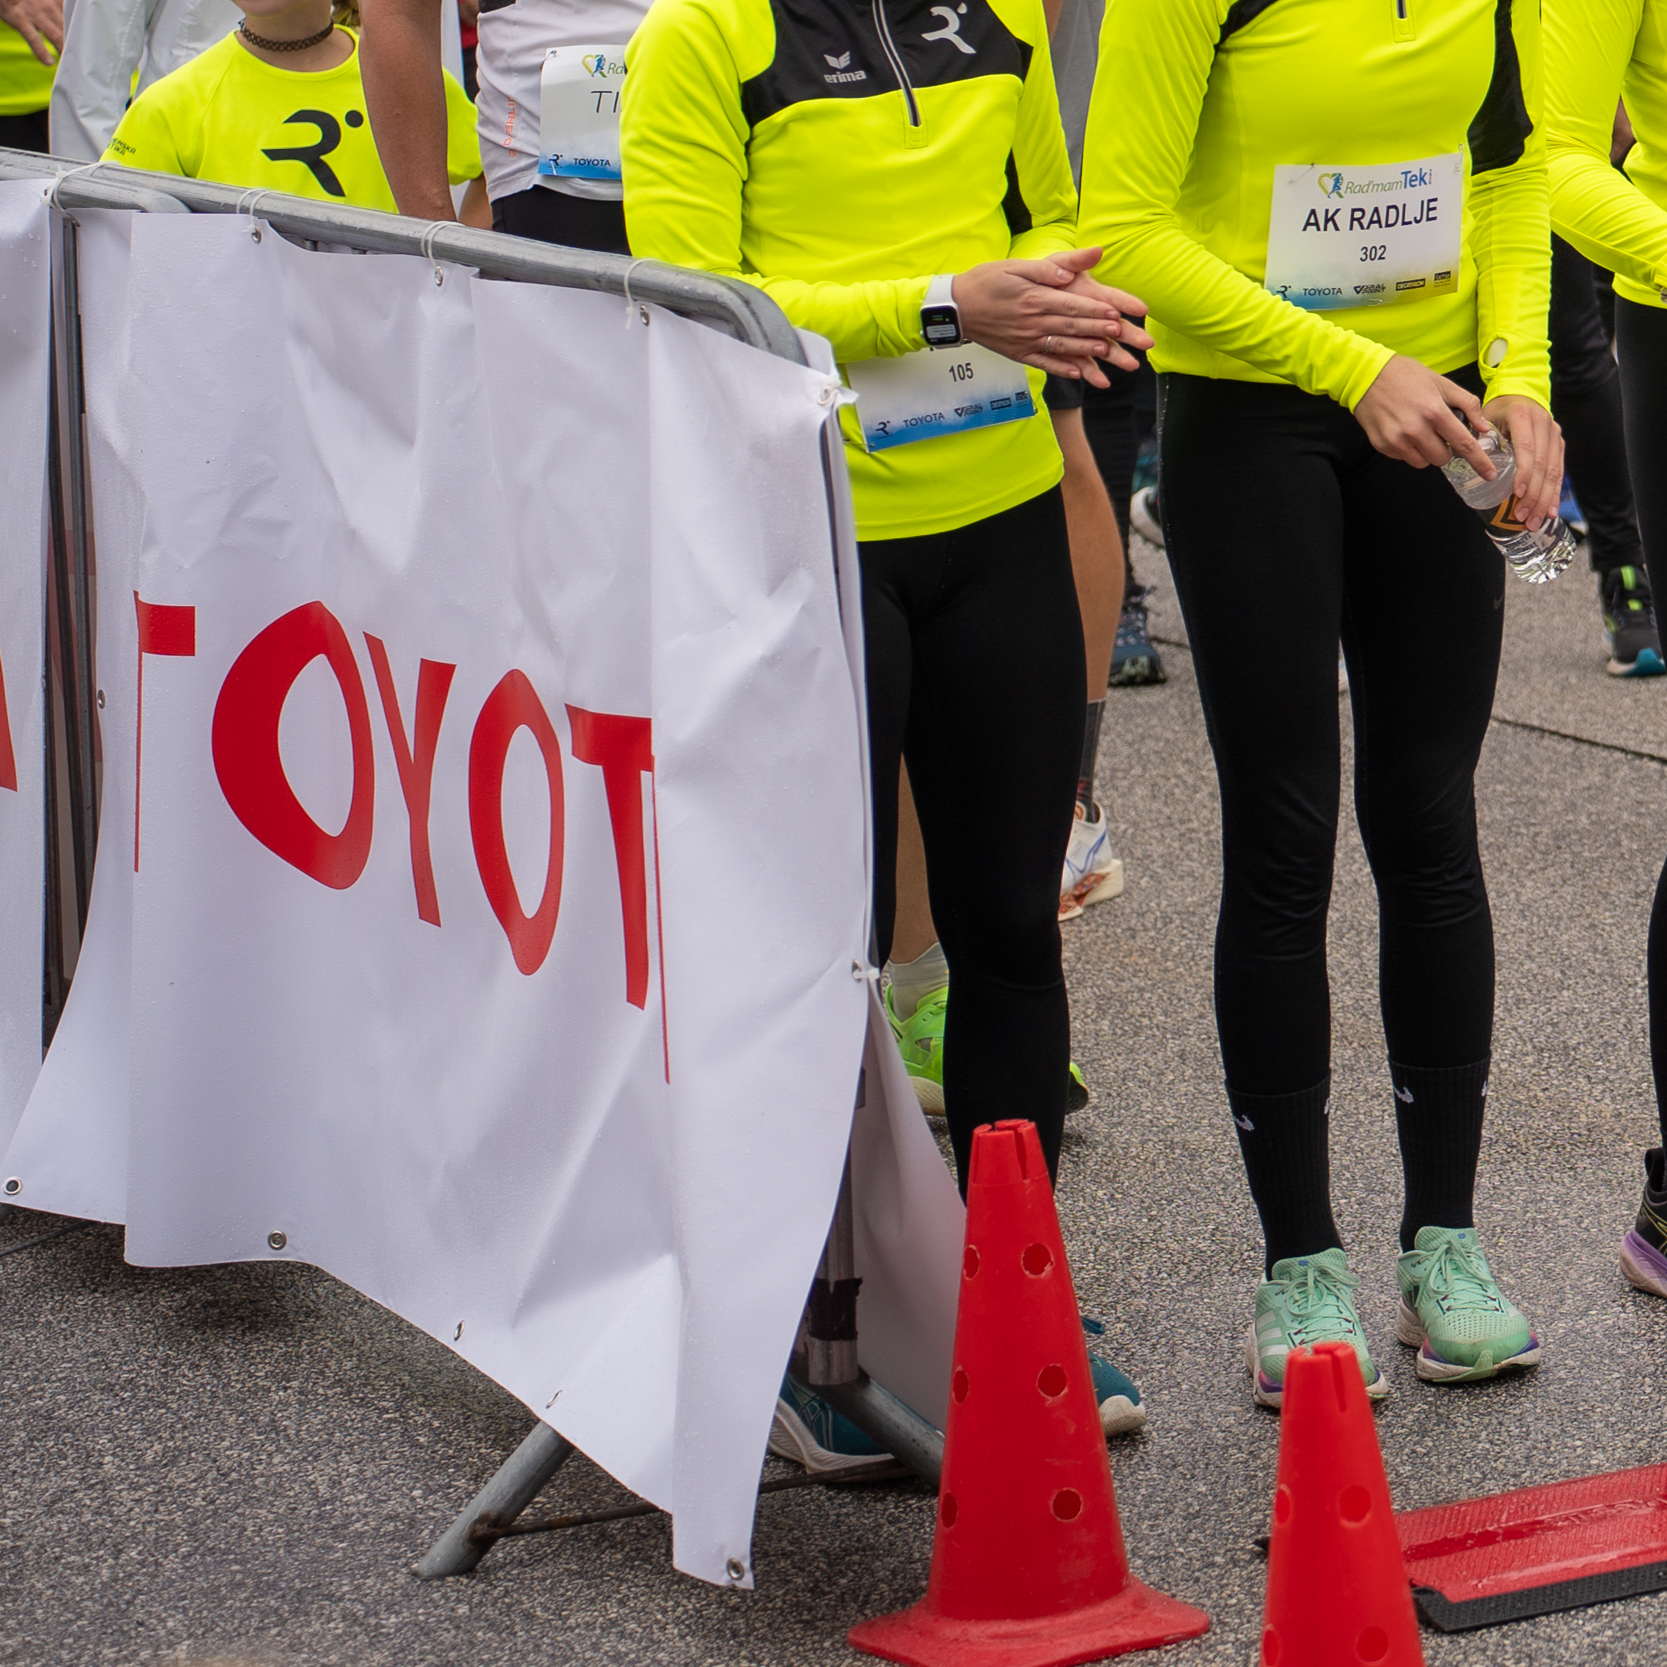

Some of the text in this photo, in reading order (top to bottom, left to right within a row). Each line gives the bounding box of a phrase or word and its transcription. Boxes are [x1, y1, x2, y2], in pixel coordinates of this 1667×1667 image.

[823, 69, 867, 84] erima
[573, 158, 611, 167] TOYOTA
[1302, 197, 1439, 232] AK RADLJE
[1360, 244, 1387, 262] 302
[1303, 287, 1343, 296] TOYOTA
[949, 362, 974, 382] 105
[903, 412, 945, 428] TOYOTA
